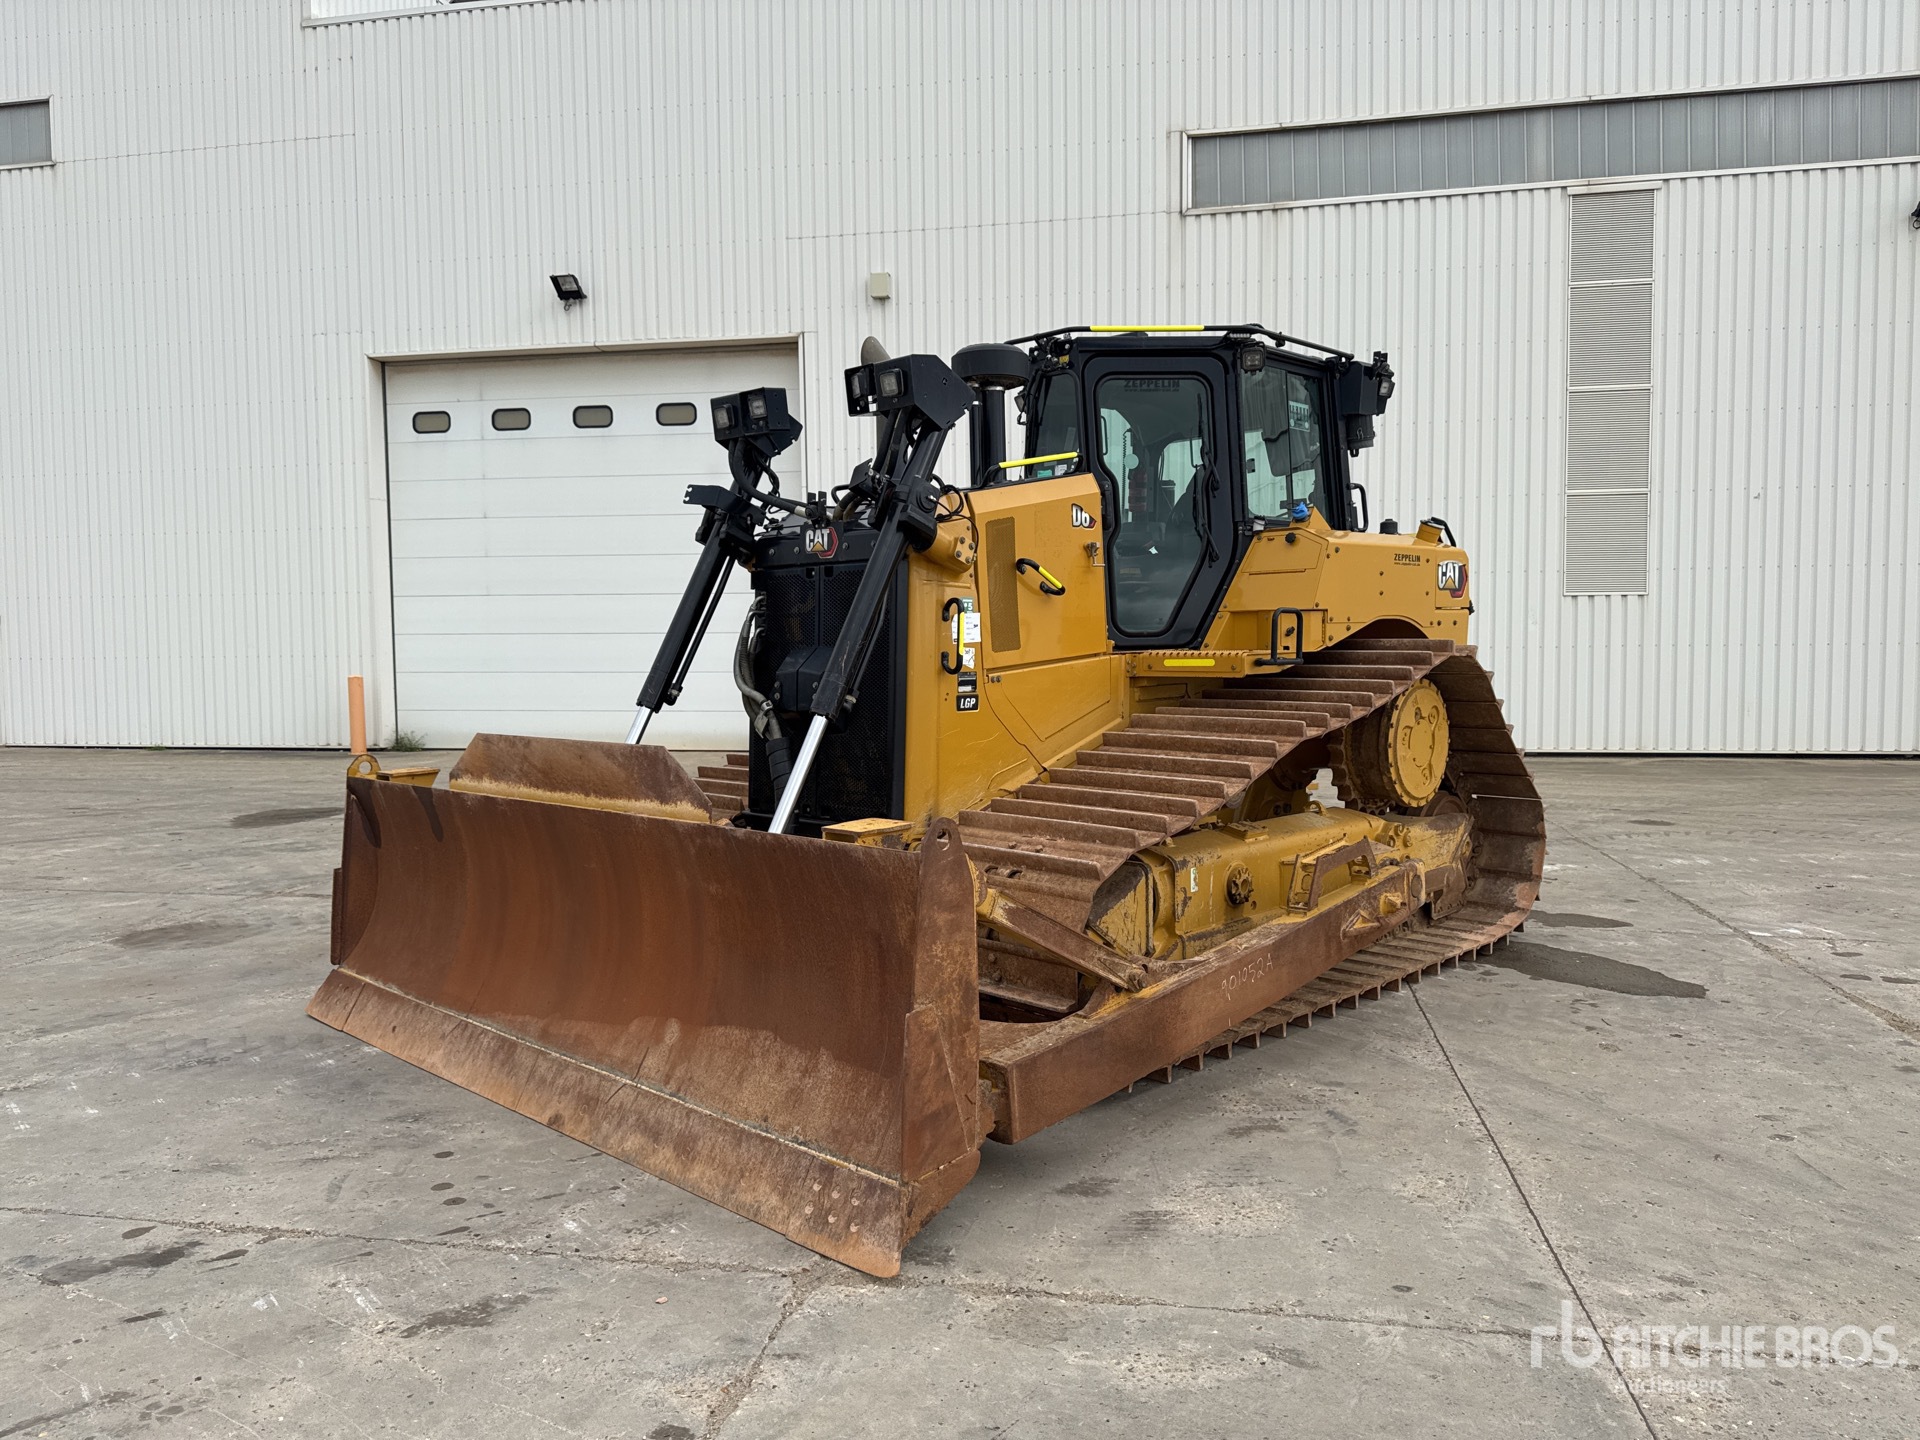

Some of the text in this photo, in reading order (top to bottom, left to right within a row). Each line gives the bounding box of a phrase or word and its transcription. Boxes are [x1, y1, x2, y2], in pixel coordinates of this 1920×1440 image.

[1124, 379, 1180, 388] ZEPPELIN
[1072, 504, 1090, 527] D6
[805, 528, 830, 552] CAT
[1393, 553, 1421, 563] ZEPPELIN
[1438, 561, 1460, 590] CAT
[960, 697, 977, 709] LGP
